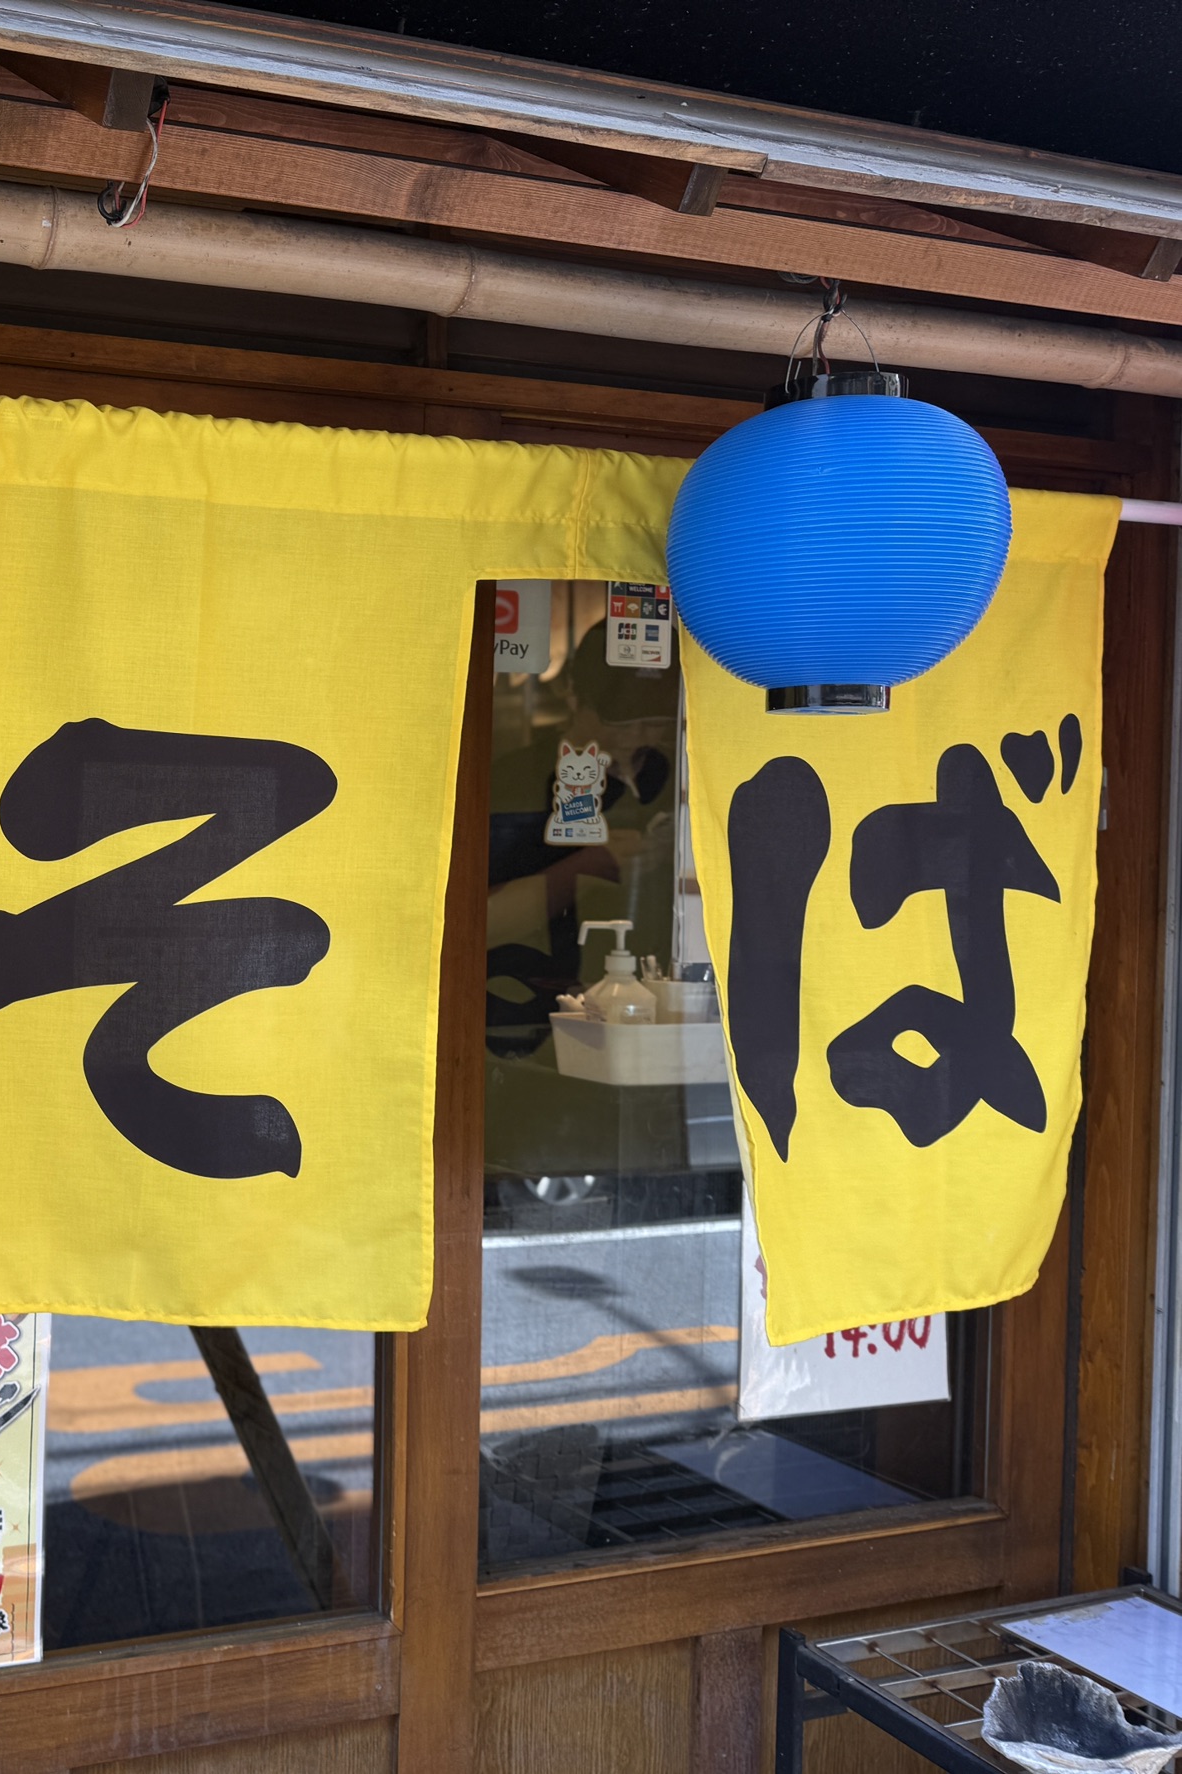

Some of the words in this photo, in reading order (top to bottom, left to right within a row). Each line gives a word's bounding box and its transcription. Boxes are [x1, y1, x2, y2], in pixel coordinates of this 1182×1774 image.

[628, 586, 654, 594] WELCOME
[564, 801, 583, 810] CARDS
[565, 806, 593, 816] WELCOME
